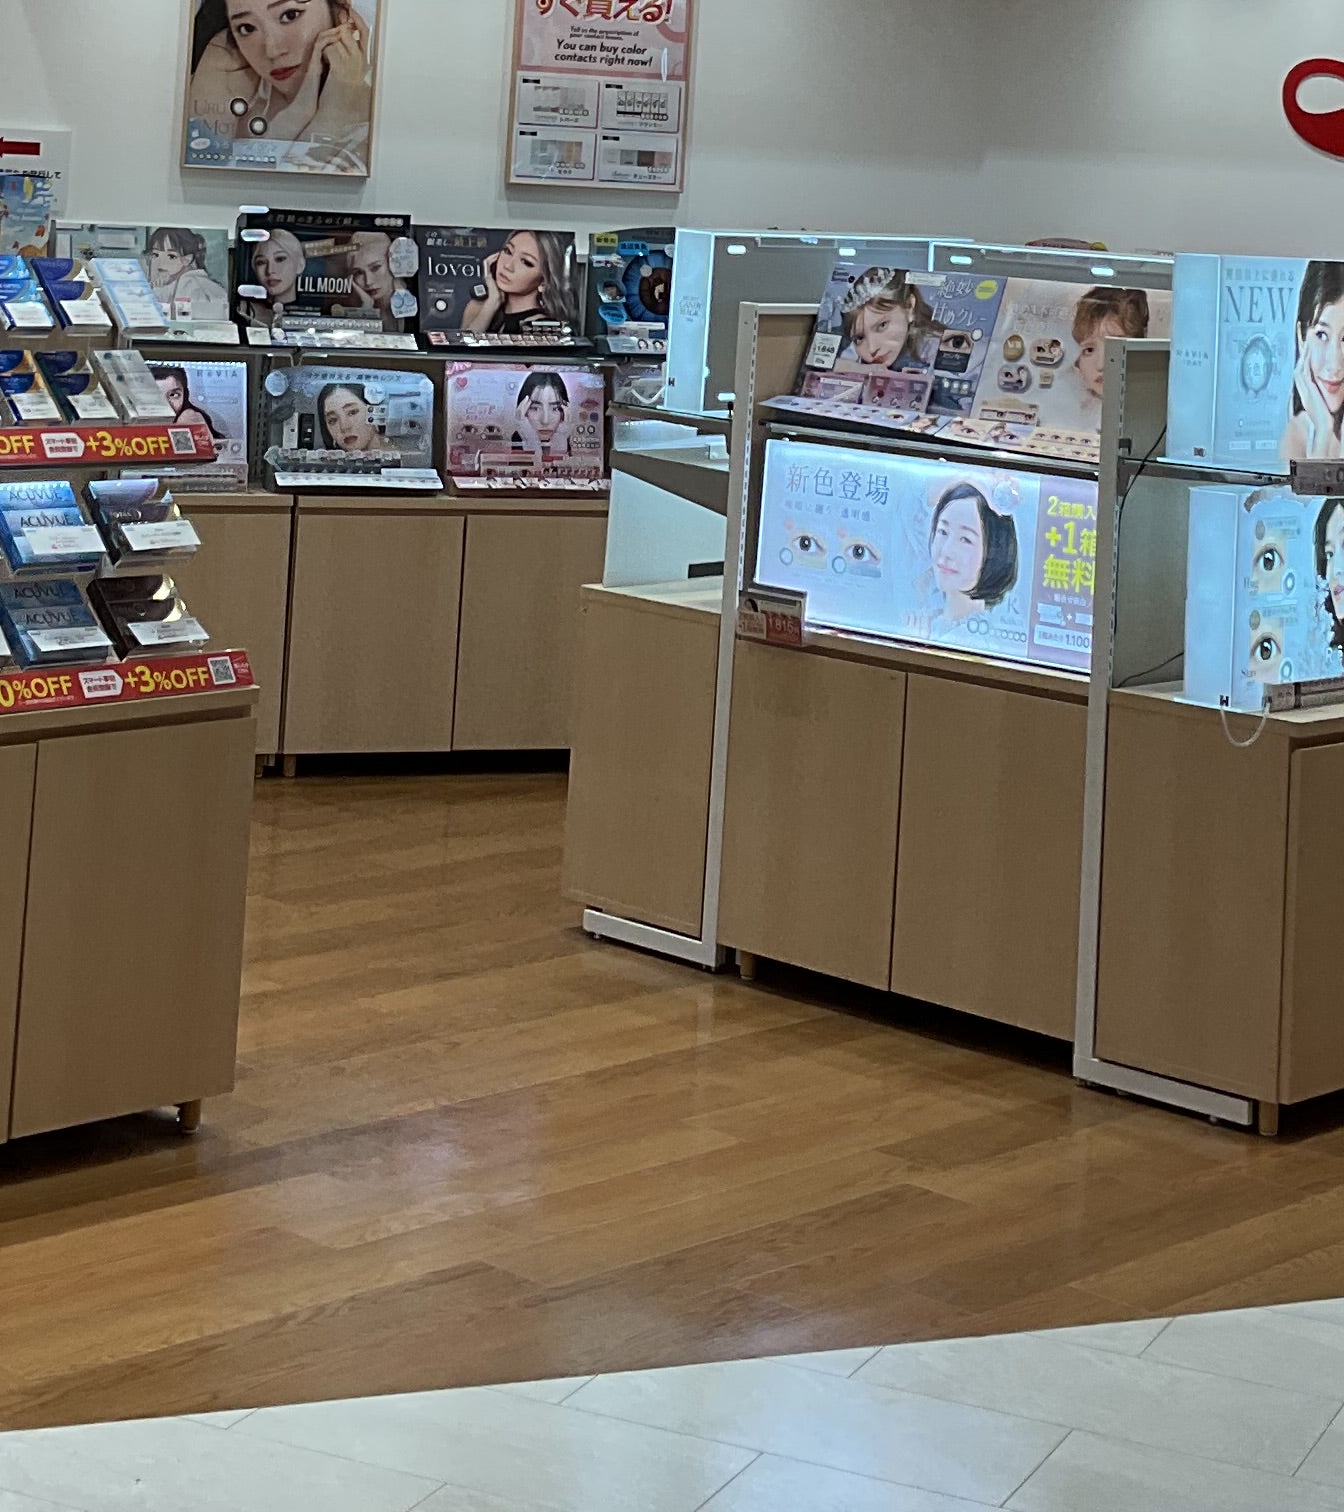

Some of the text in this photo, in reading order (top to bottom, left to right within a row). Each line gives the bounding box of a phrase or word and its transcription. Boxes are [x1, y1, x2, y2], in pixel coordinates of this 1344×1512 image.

[556, 39, 648, 55] You can buy color
[554, 53, 654, 67] contacts right now!
[296, 275, 353, 294] LIL MOON
[1223, 285, 1295, 324] NEW
[85, 431, 172, 457] +3%OFF
[785, 463, 891, 506] 新色登場
[8, 488, 63, 504] ACUVUE
[20, 511, 74, 527] ACUVUE
[1042, 553, 1096, 596] 無料
[13, 583, 65, 599] ACUVUE
[25, 611, 80, 628] ACUVUE
[123, 665, 211, 694] +3%OFF
